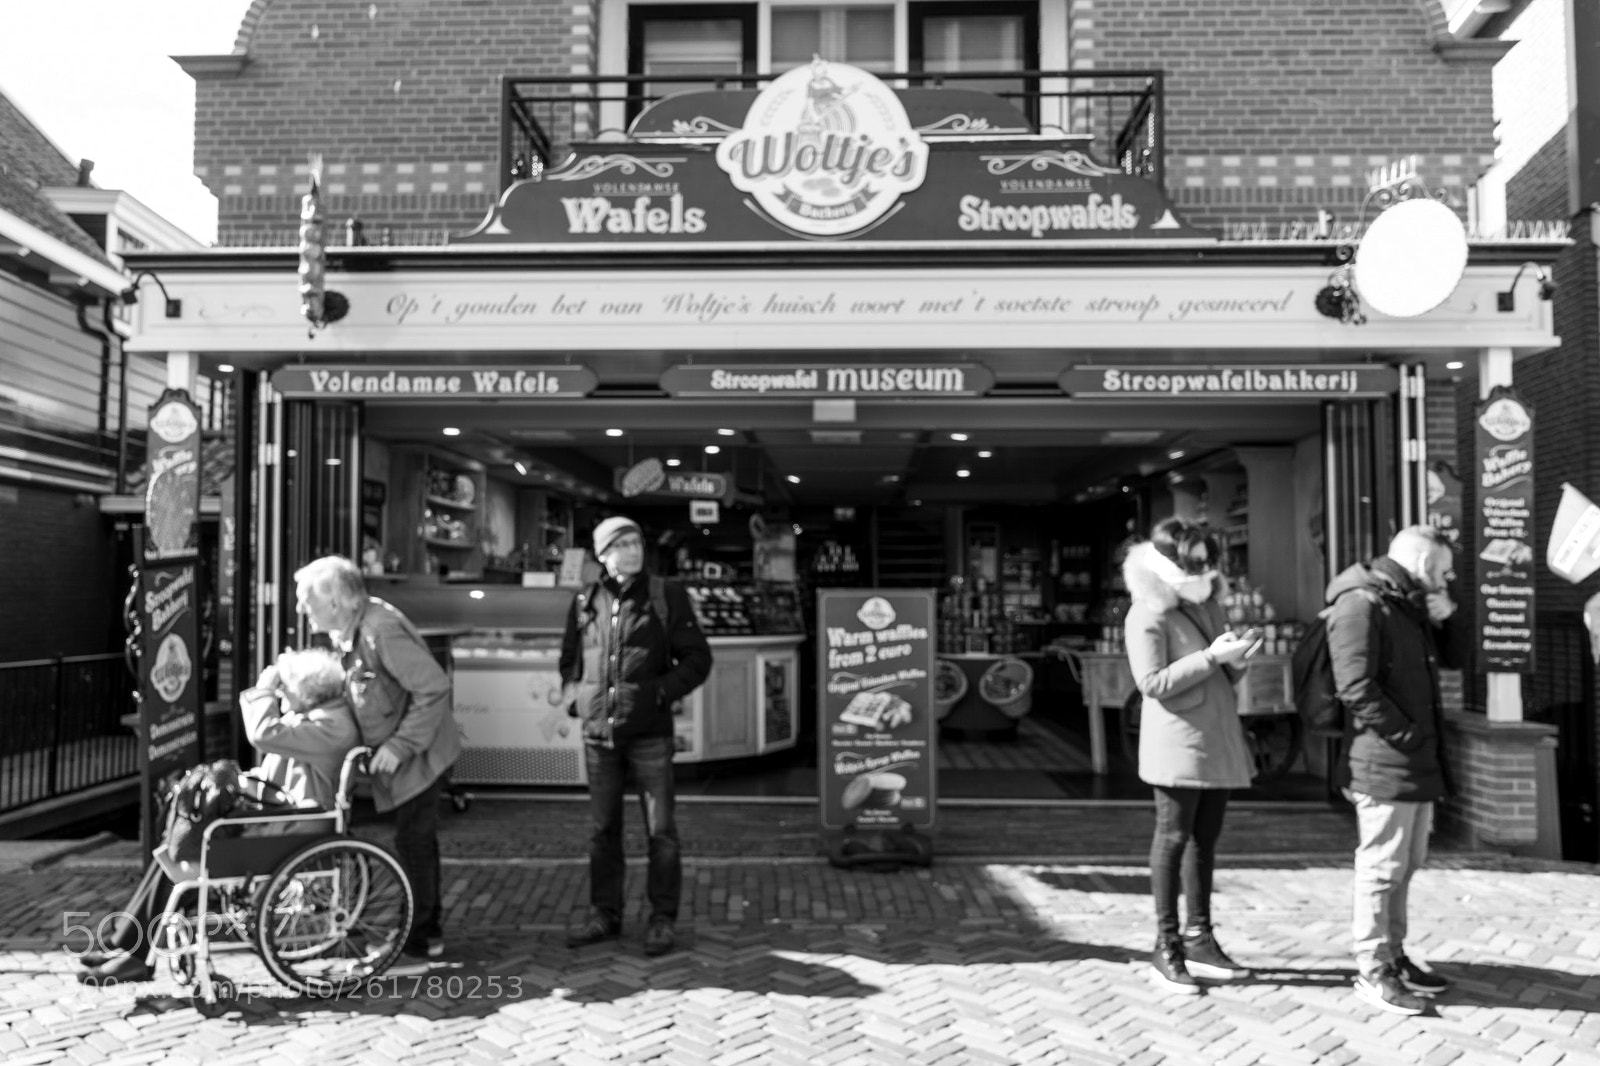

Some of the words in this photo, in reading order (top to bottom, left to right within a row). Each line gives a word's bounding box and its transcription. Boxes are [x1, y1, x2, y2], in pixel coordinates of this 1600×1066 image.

[729, 131, 916, 187] Woltje's
[561, 193, 708, 234] Wafels
[958, 192, 1138, 238] Stroopwafels
[386, 293, 419, 325] Op
[444, 293, 537, 323] gouden
[601, 303, 643, 315] van
[662, 292, 752, 323] Woltje's
[762, 292, 836, 315] huisch
[849, 297, 906, 315] wort
[1084, 294, 1161, 321] stroop
[1168, 289, 1295, 321] gesmeerd
[309, 370, 461, 393] Volendamse
[472, 371, 560, 393] Wafels
[710, 369, 818, 393] Stroopwafel
[827, 367, 964, 392] museum
[1102, 369, 1359, 394] Stroopwafelbakkerij
[827, 627, 874, 647] Warm
[828, 648, 864, 669] from
[865, 645, 878, 663] 2
[878, 643, 913, 661] euro
